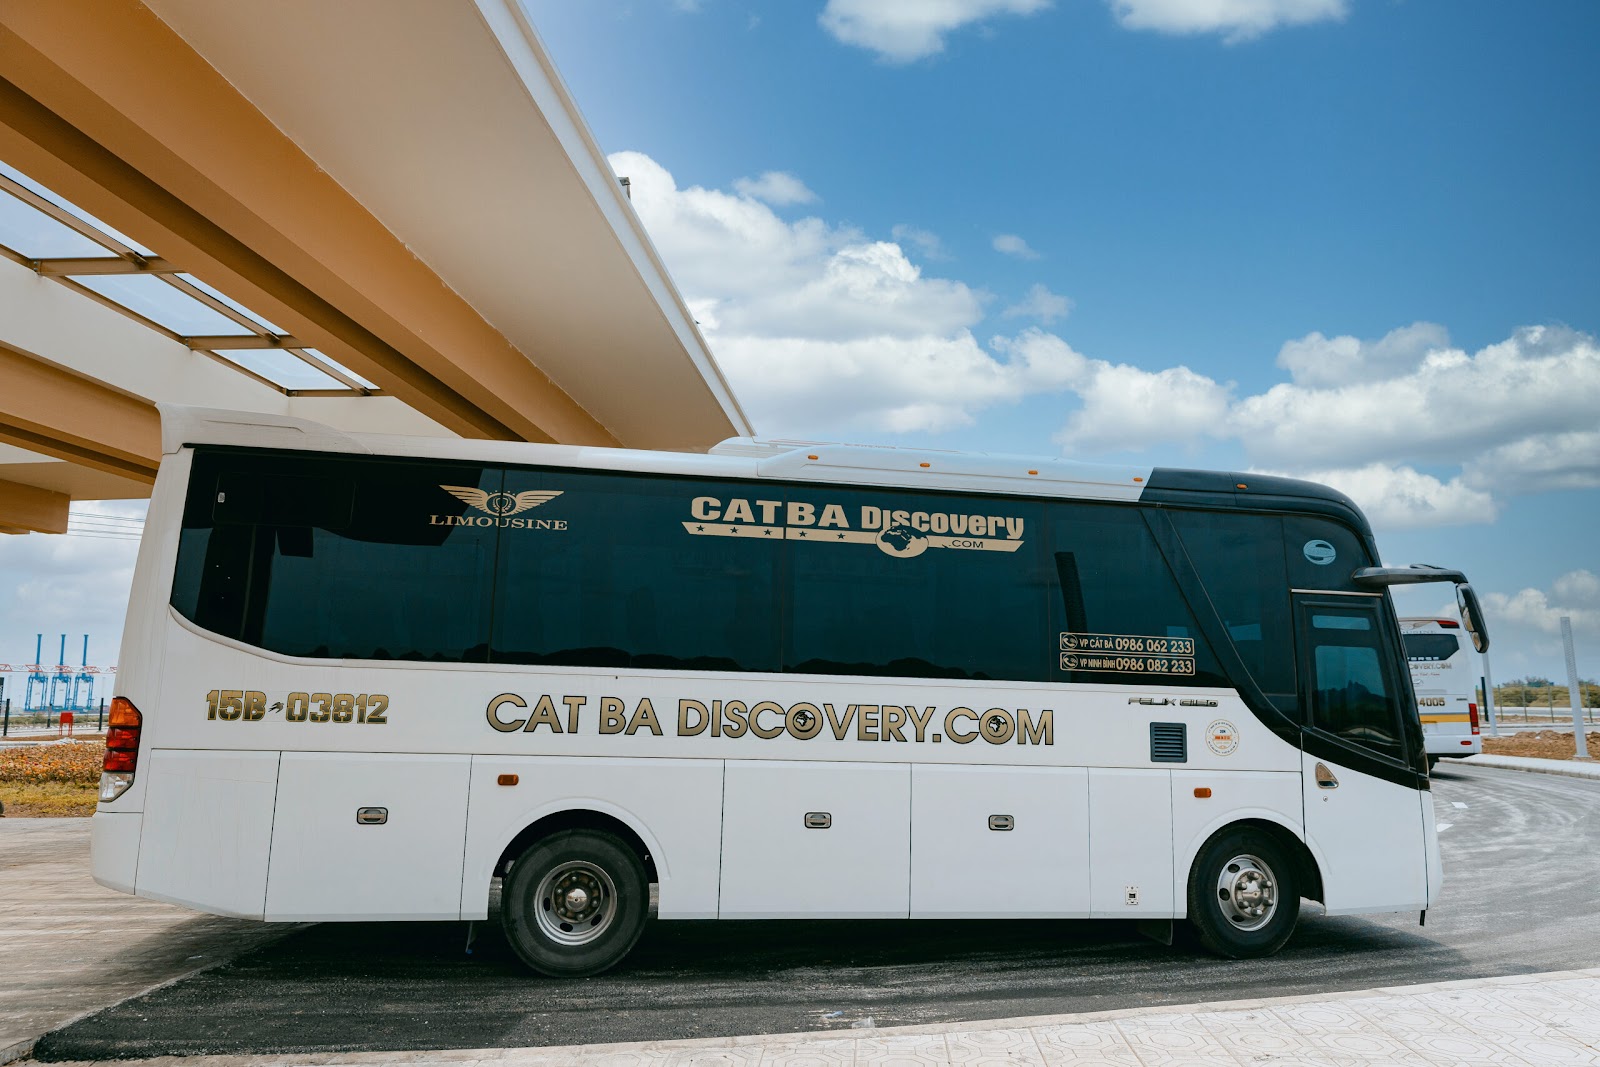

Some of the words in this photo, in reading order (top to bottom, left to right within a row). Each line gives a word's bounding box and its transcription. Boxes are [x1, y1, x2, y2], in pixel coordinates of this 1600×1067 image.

[429, 514, 568, 531] LIMOUSINE
[1079, 638, 1088, 648] VP
[1089, 636, 1103, 649] CÁT
[1104, 636, 1114, 649] BÀ
[1115, 638, 1144, 651] 0986
[1146, 639, 1168, 652] 062
[1170, 640, 1192, 654] 233
[1079, 658, 1088, 668] VP
[1088, 659, 1102, 668] NINH
[1102, 657, 1116, 669] BÌNH
[1115, 658, 1145, 671] 0986
[1147, 659, 1168, 672] 082
[1171, 660, 1193, 673] 233
[205, 689, 267, 722] 15B
[285, 691, 390, 724] 03812
[486, 692, 587, 734] CAT
[599, 696, 664, 736] BA
[677, 698, 1054, 746] DISCOVERY.COM
